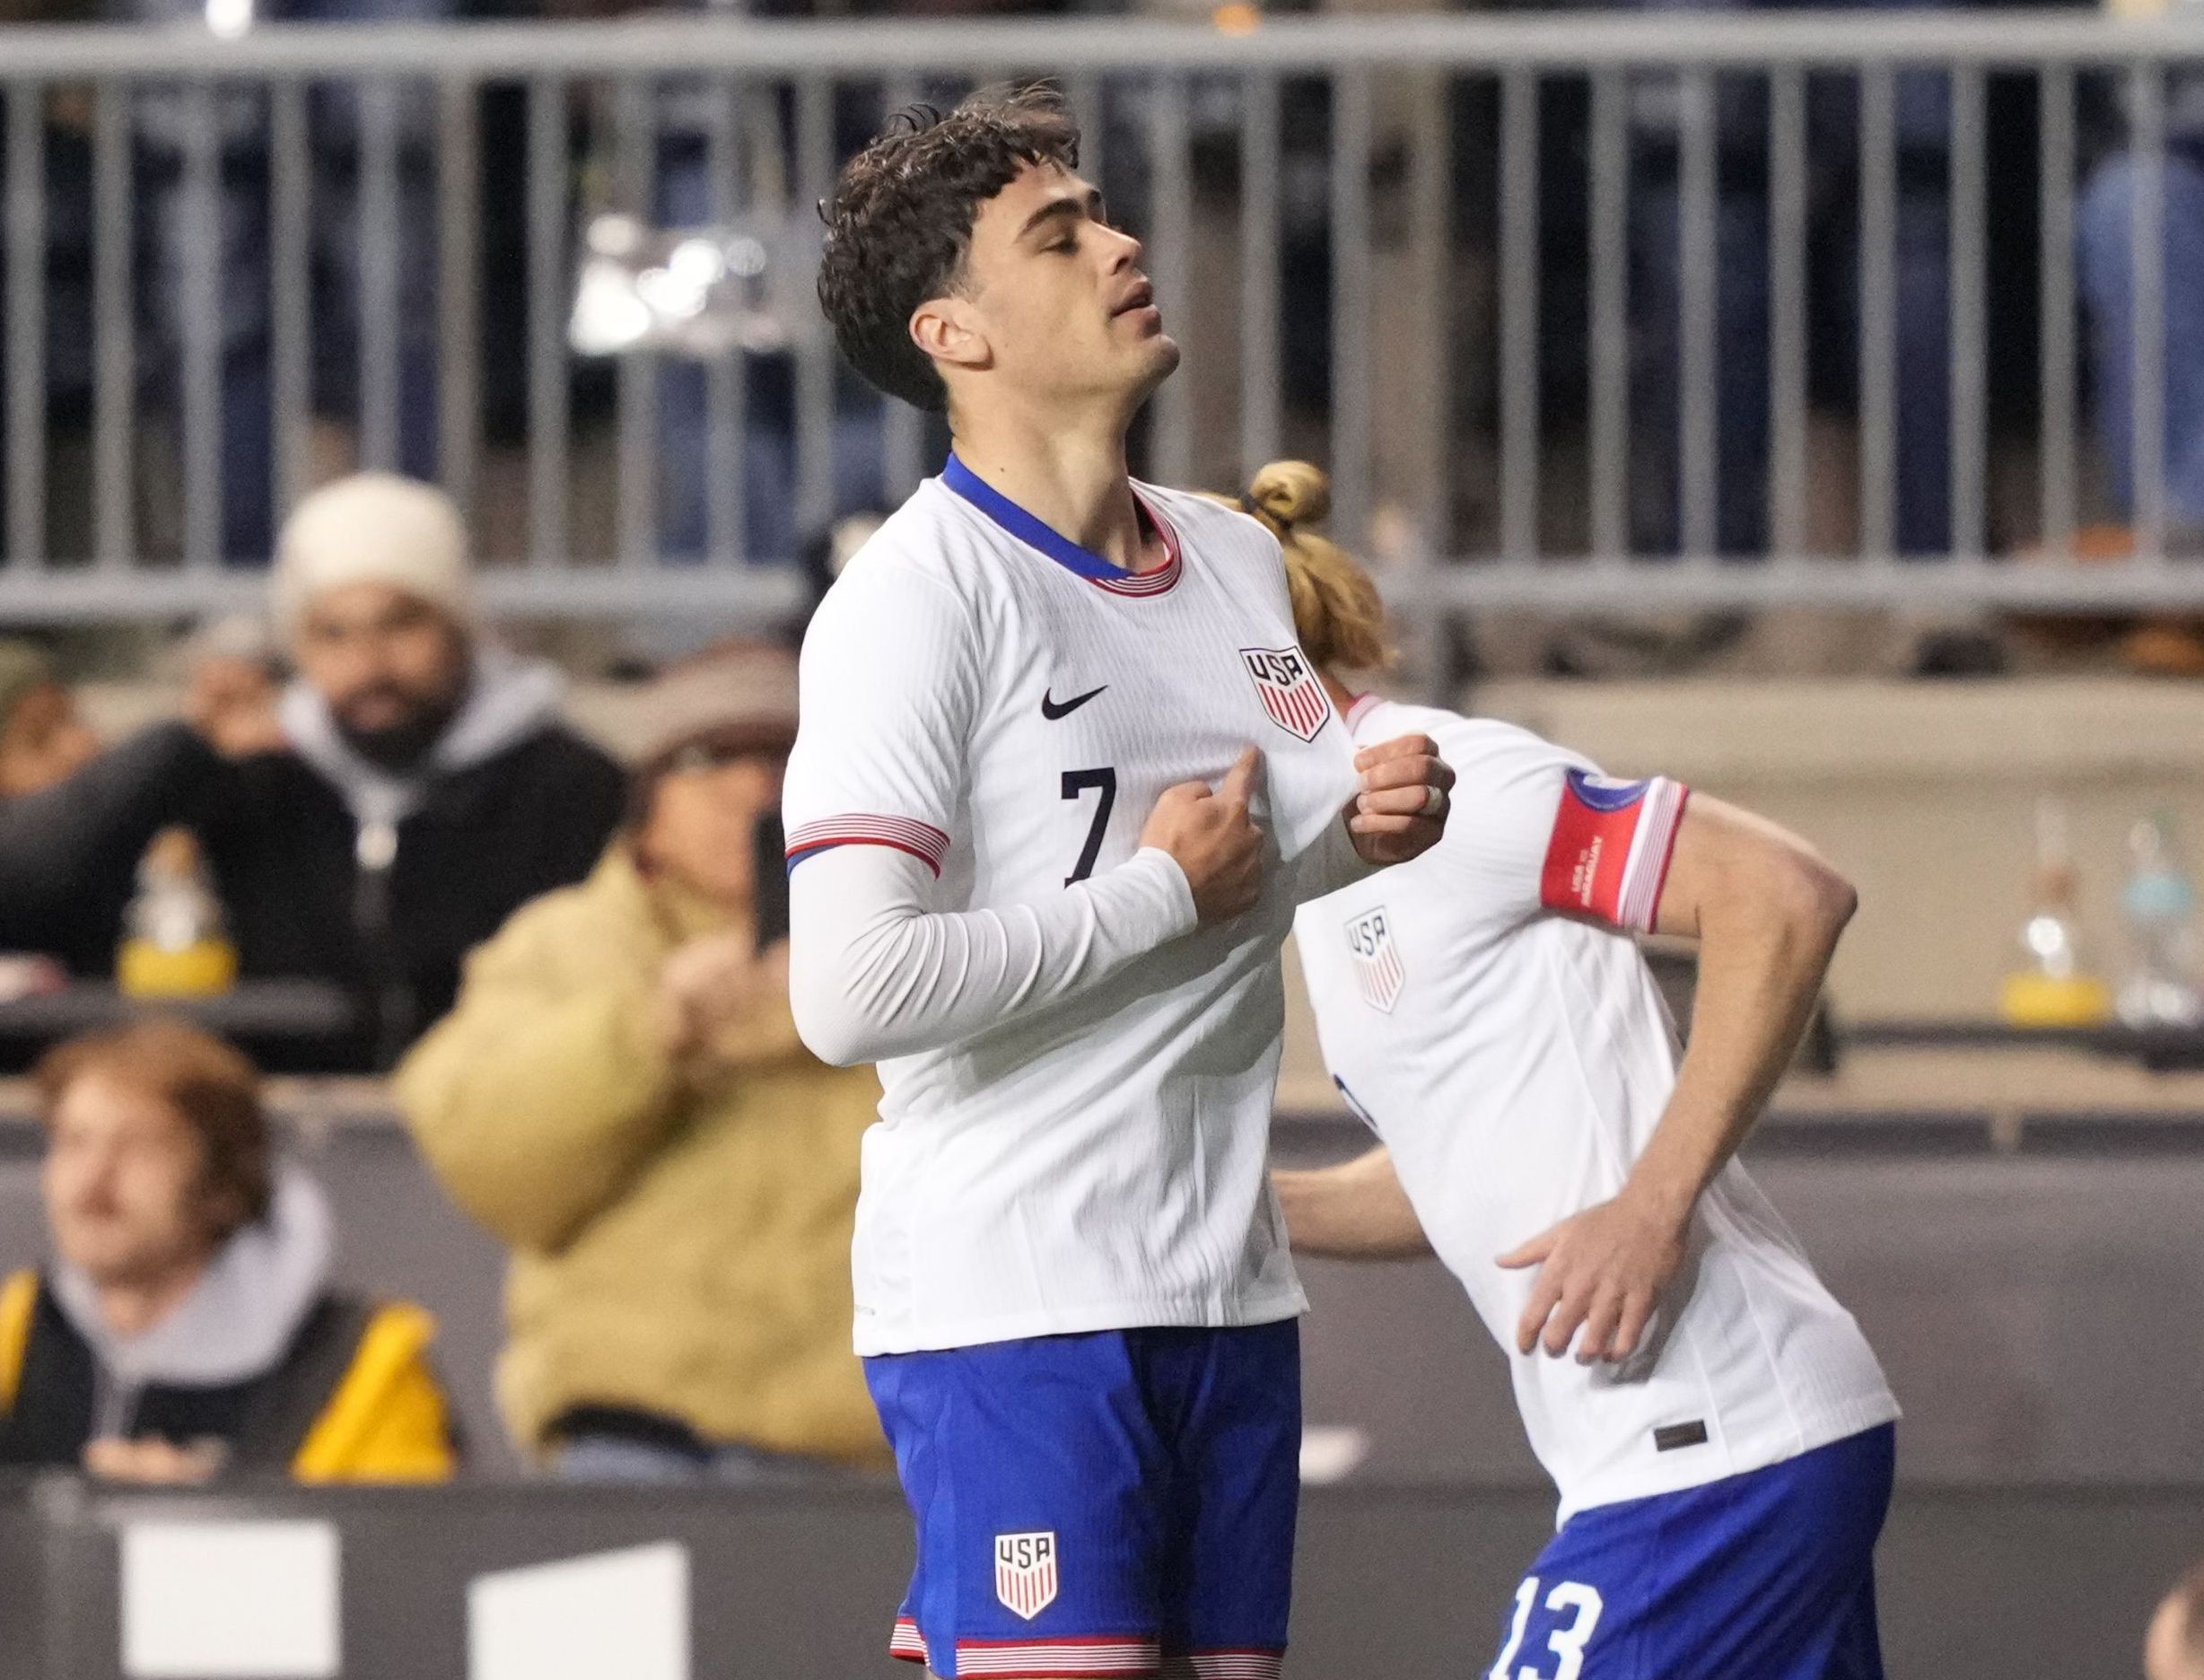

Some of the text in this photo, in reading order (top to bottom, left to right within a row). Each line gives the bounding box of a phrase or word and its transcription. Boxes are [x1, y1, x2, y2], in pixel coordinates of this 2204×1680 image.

[1246, 653, 1304, 687] USA
[1061, 766, 1117, 890] 7
[1348, 914, 1386, 957] USA
[1000, 1537, 1051, 1570] USA
[1489, 1576, 1604, 1680] 13
